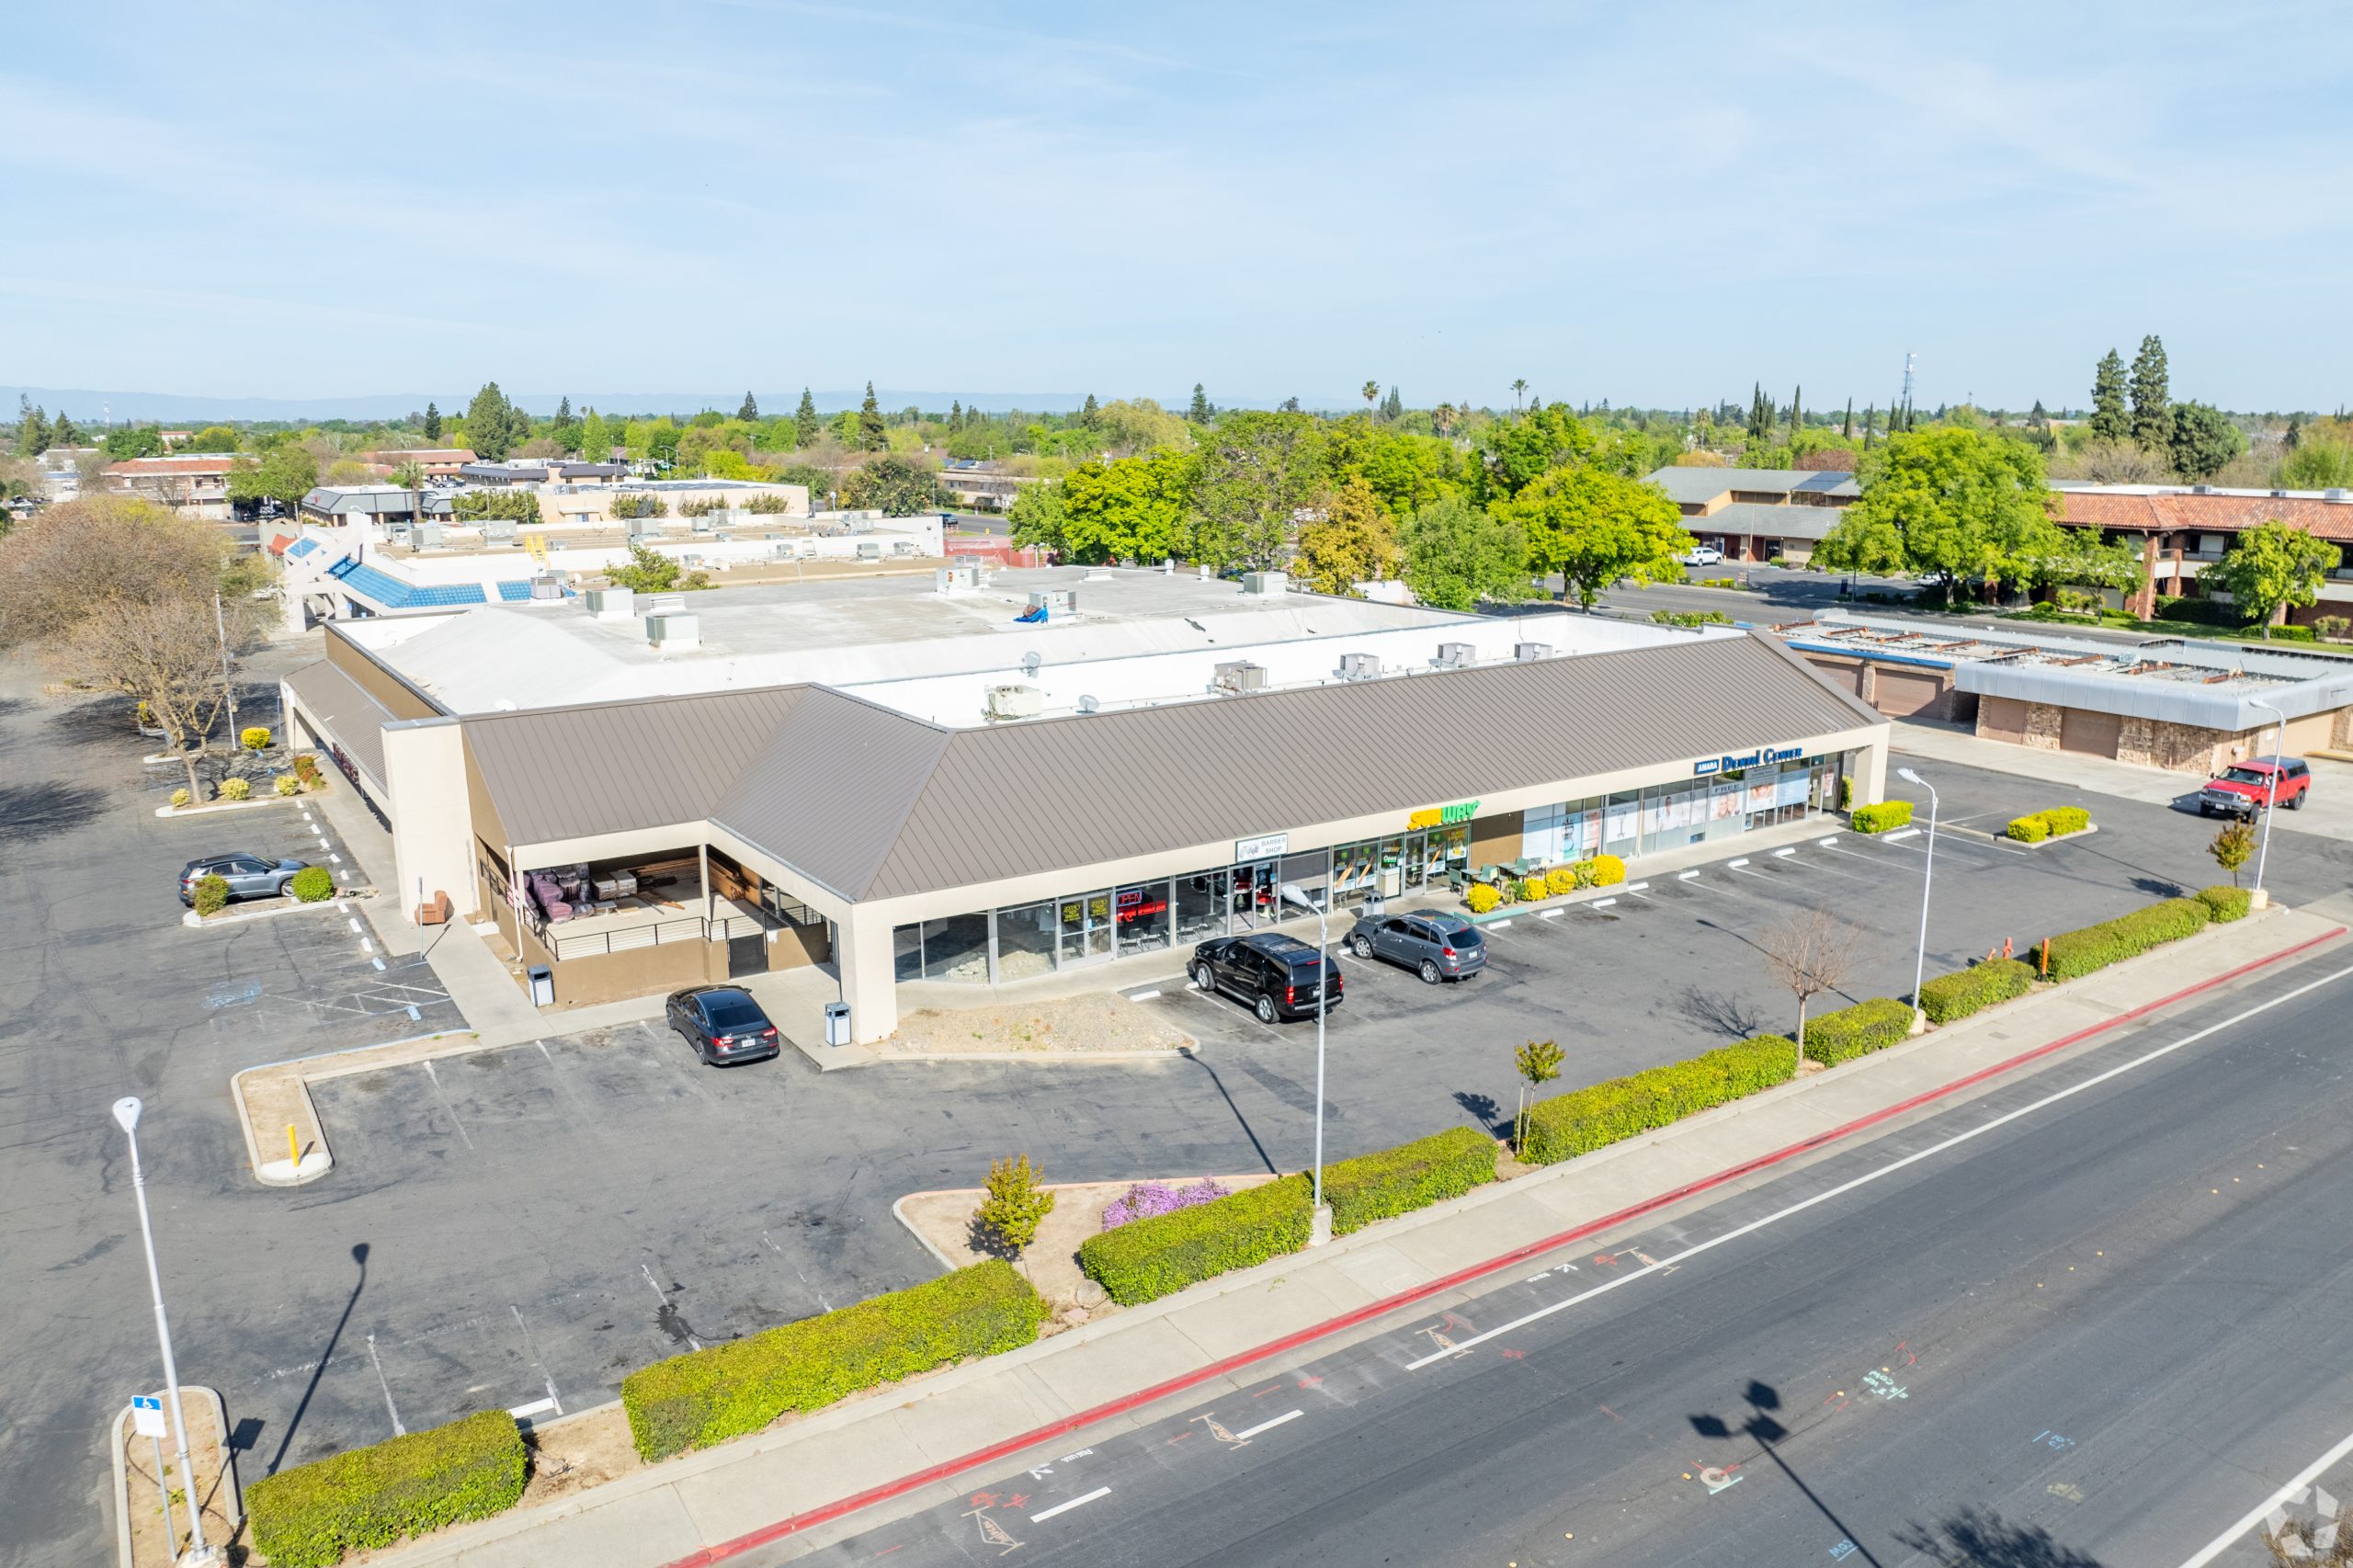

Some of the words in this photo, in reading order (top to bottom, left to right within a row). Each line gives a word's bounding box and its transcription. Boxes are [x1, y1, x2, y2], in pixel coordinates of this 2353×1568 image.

[1698, 762, 1718, 773] AMARA
[1715, 783, 1740, 792] FREE
[1407, 800, 1481, 831] SUBWAY
[1261, 837, 1286, 846] BARBER
[1265, 846, 1282, 854] SHOP
[1117, 892, 1141, 905] OPEN
